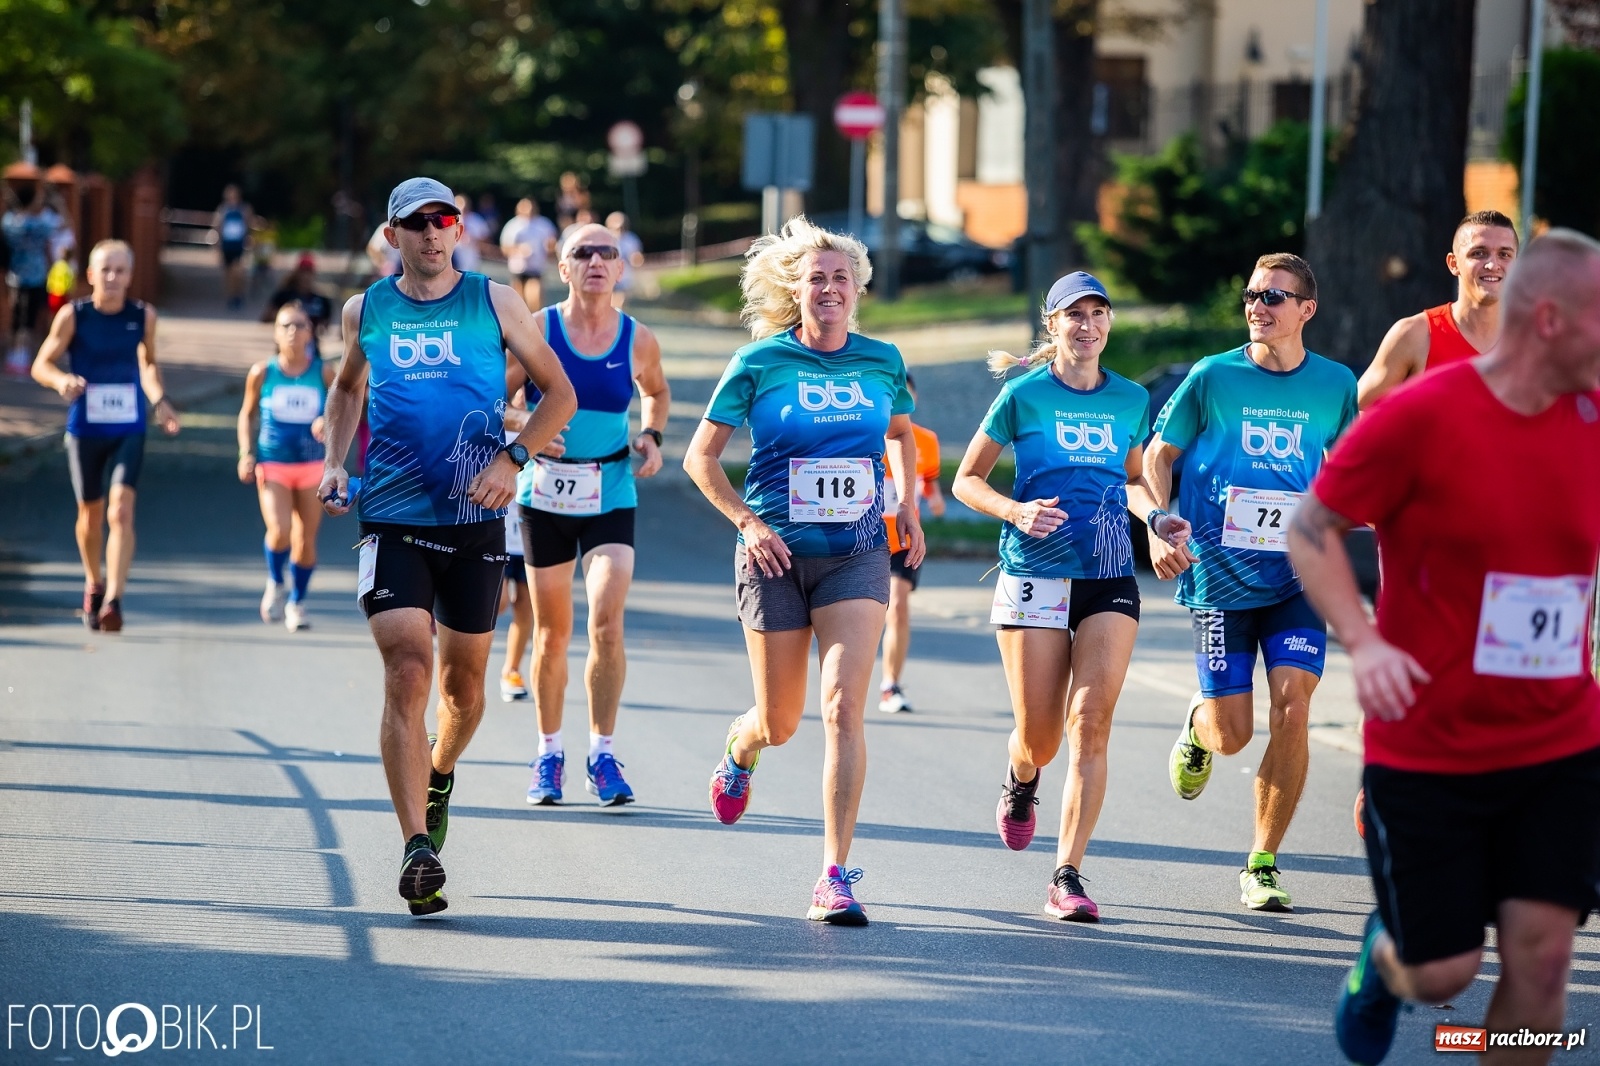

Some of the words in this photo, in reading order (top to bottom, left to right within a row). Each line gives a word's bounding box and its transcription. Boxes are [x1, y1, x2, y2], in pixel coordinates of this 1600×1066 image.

[390, 331, 462, 369] bbl
[404, 370, 449, 381] RACIBÓRZ
[798, 380, 875, 412] bbl
[813, 413, 862, 424] RACIBÓRZ
[1055, 421, 1119, 453] bbl
[1241, 420, 1305, 460] bbl
[1069, 455, 1107, 465] RACIBÓRZ
[554, 478, 577, 496] 97
[815, 476, 856, 499] 118
[1256, 507, 1282, 528] 72
[414, 538, 456, 553] ICEBUG
[1021, 581, 1035, 603] 3
[1530, 606, 1561, 640] 91
